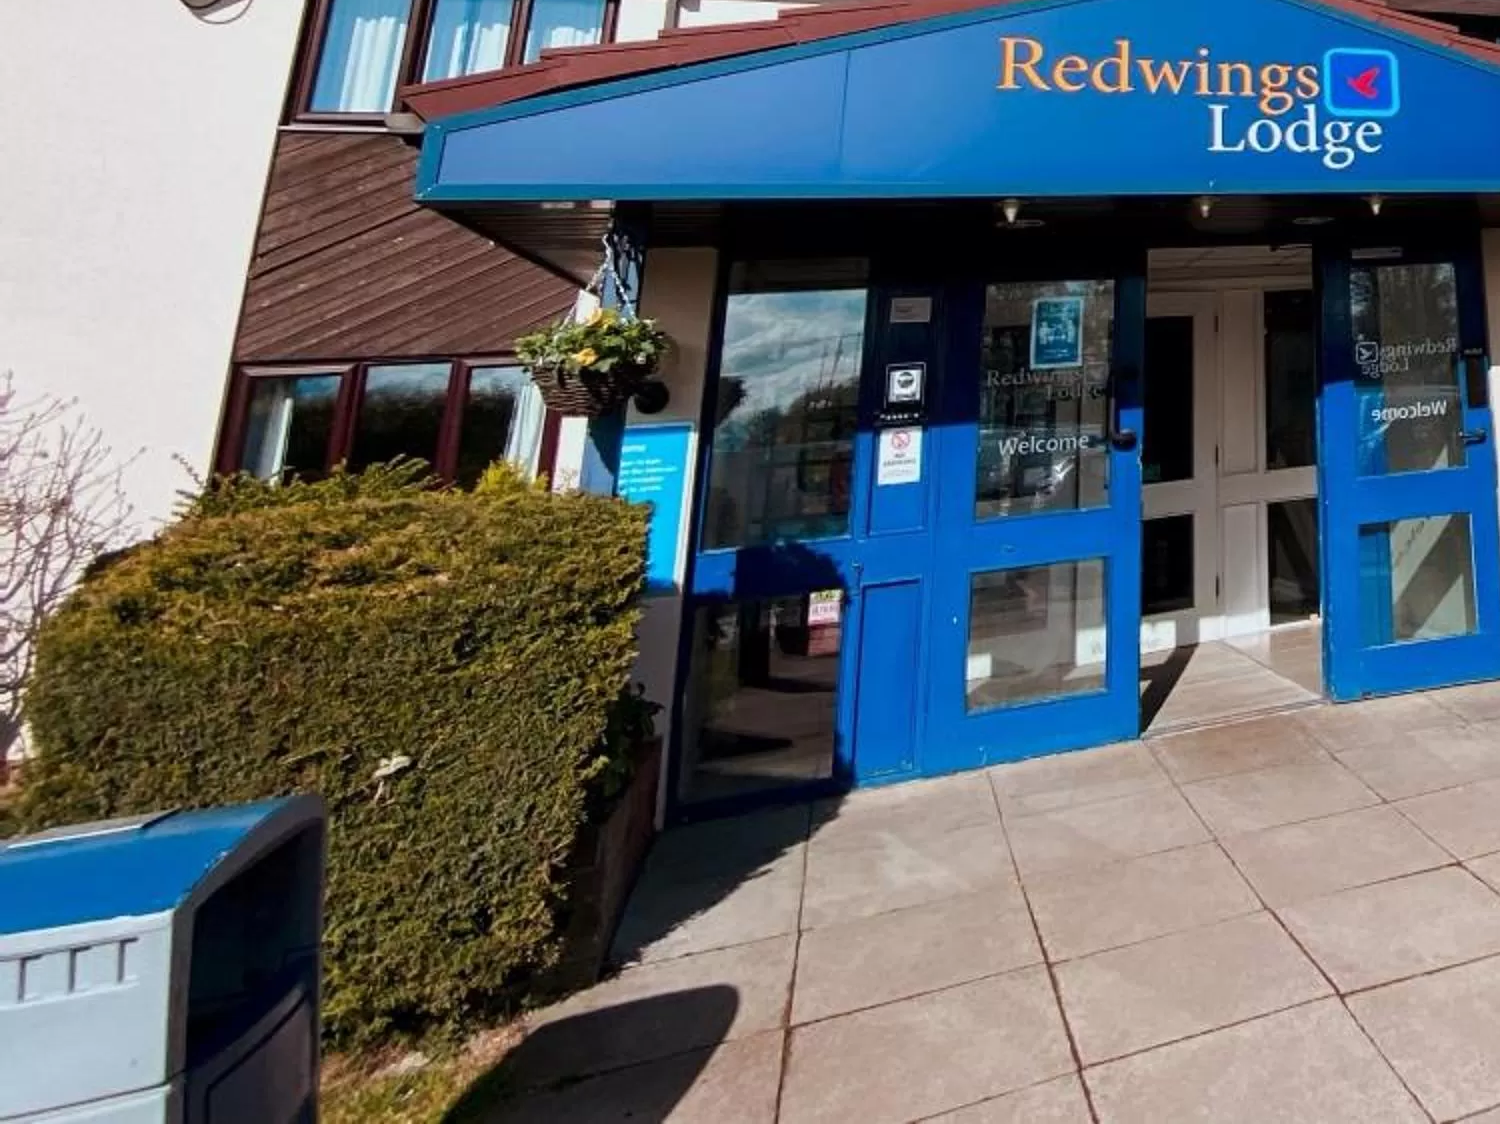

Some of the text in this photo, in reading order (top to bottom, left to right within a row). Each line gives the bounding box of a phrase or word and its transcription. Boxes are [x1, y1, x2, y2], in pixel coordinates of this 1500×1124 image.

[996, 36, 1320, 115] Redwings
[1207, 104, 1383, 169] Lodge
[998, 435, 1090, 456] Welcome
